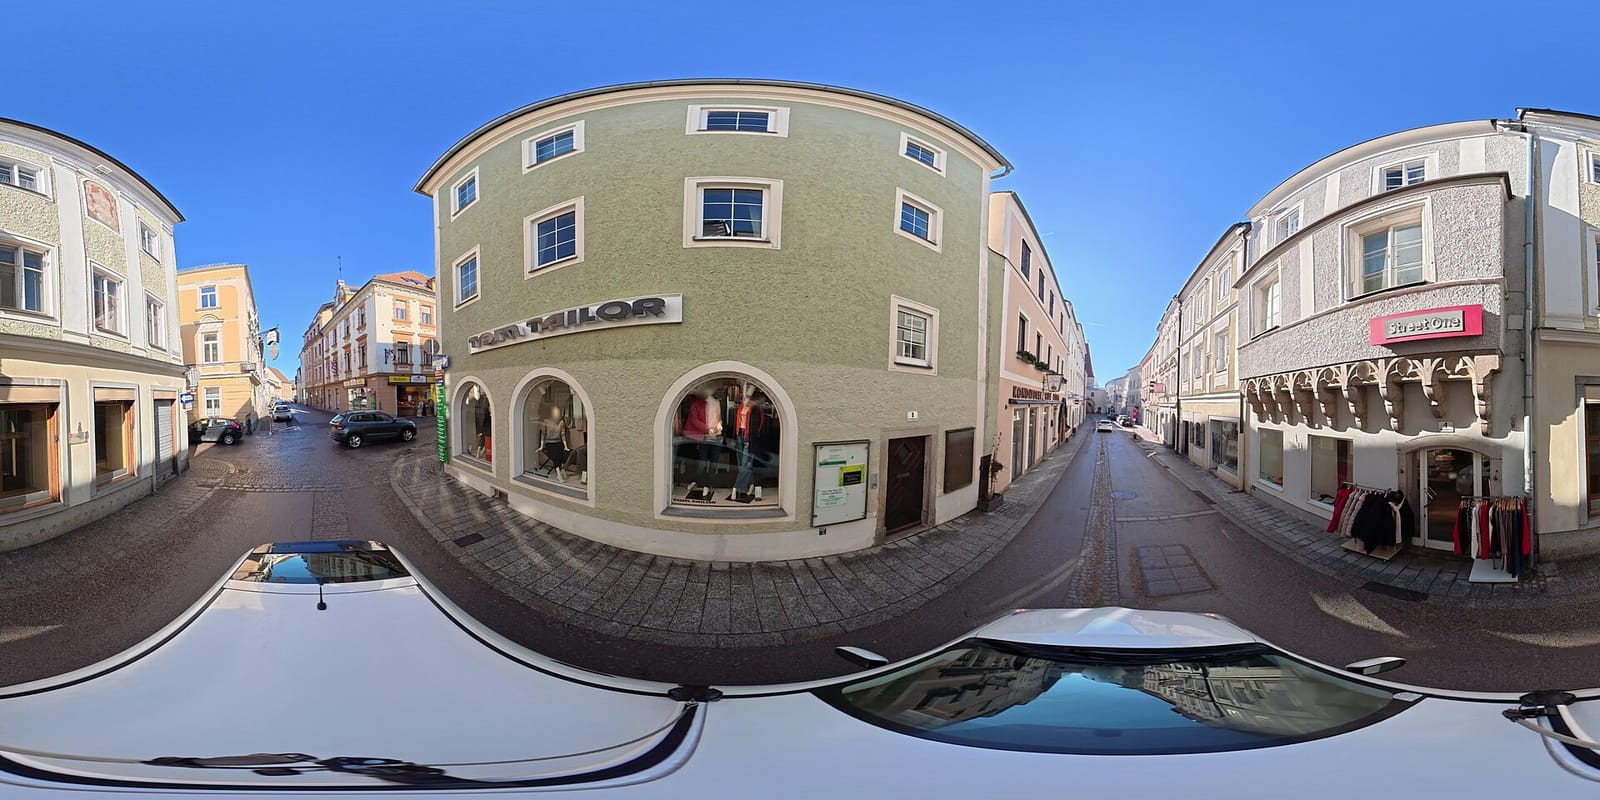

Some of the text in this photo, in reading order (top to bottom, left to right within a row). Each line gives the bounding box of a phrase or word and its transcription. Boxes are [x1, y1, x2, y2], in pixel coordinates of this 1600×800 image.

[468, 296, 667, 349] TOM TAILOR
[1389, 316, 1461, 335] Street One
